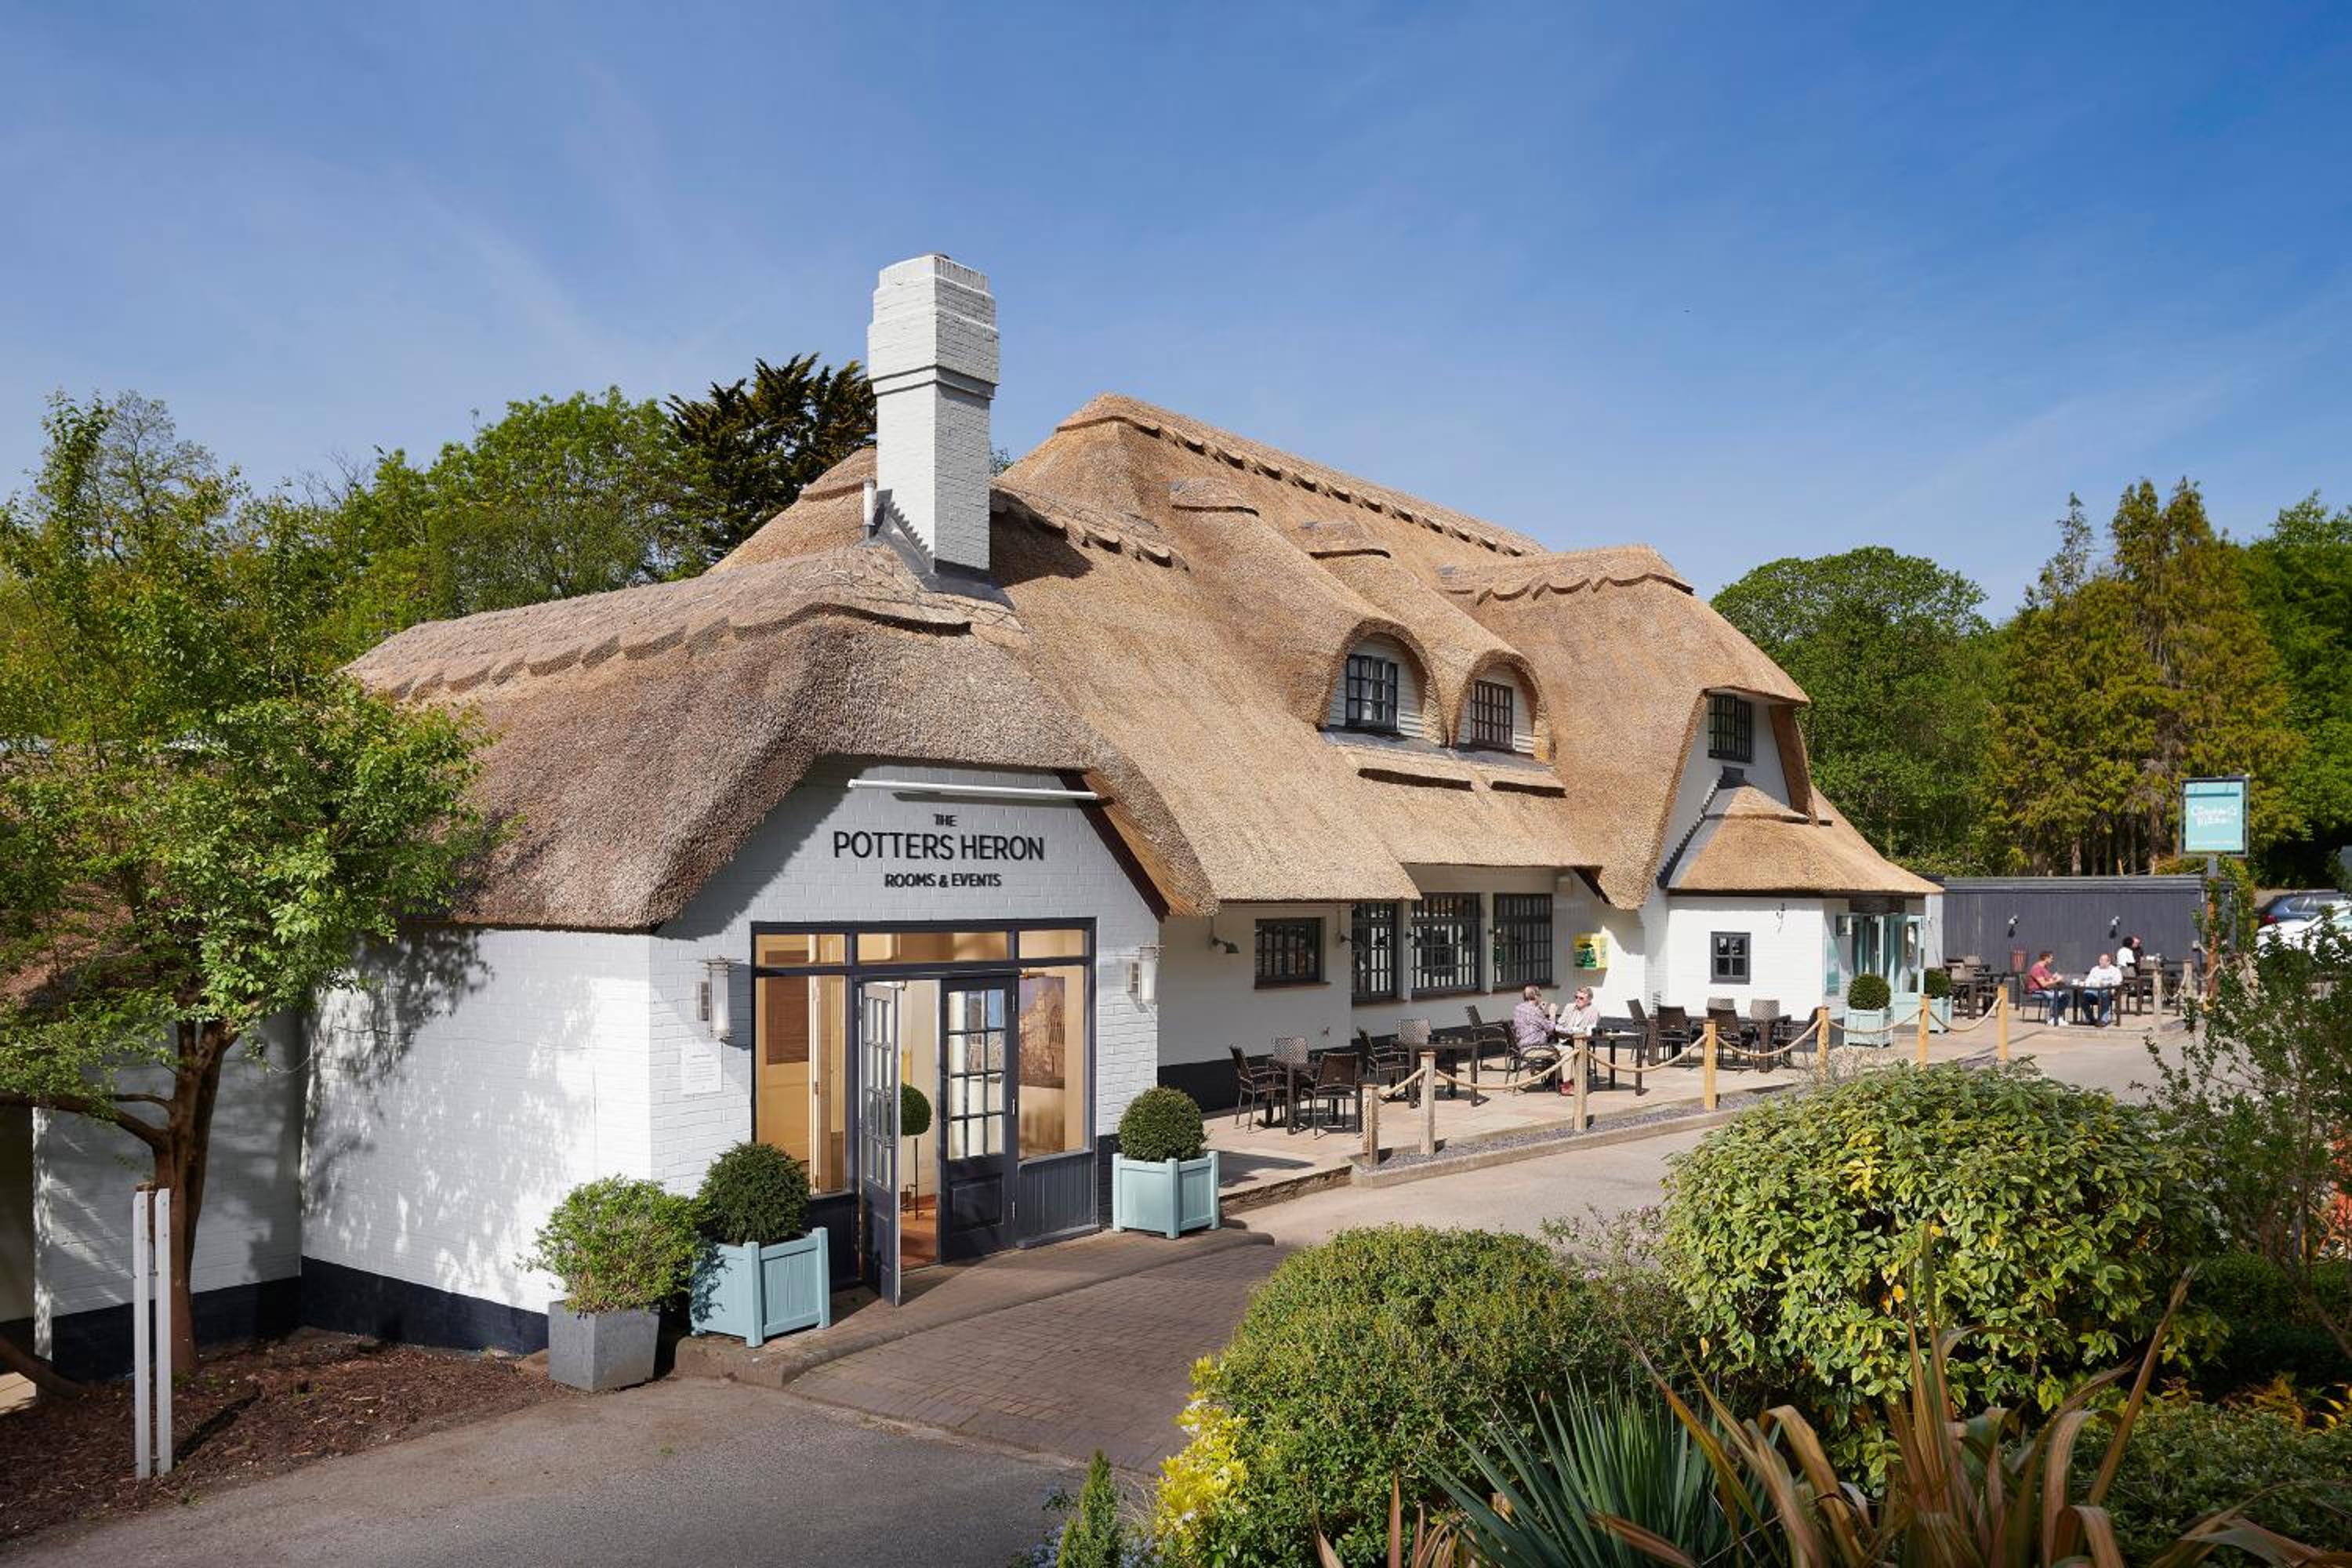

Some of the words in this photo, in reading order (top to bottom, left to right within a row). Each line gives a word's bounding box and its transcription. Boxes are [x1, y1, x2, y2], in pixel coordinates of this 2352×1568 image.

[933, 814, 957, 827] THE
[833, 831, 955, 860] POTTERS
[960, 834, 1045, 861] HERON
[884, 873, 936, 887] ROOMS
[938, 874, 949, 888] &
[951, 873, 1002, 887] EVENTS
